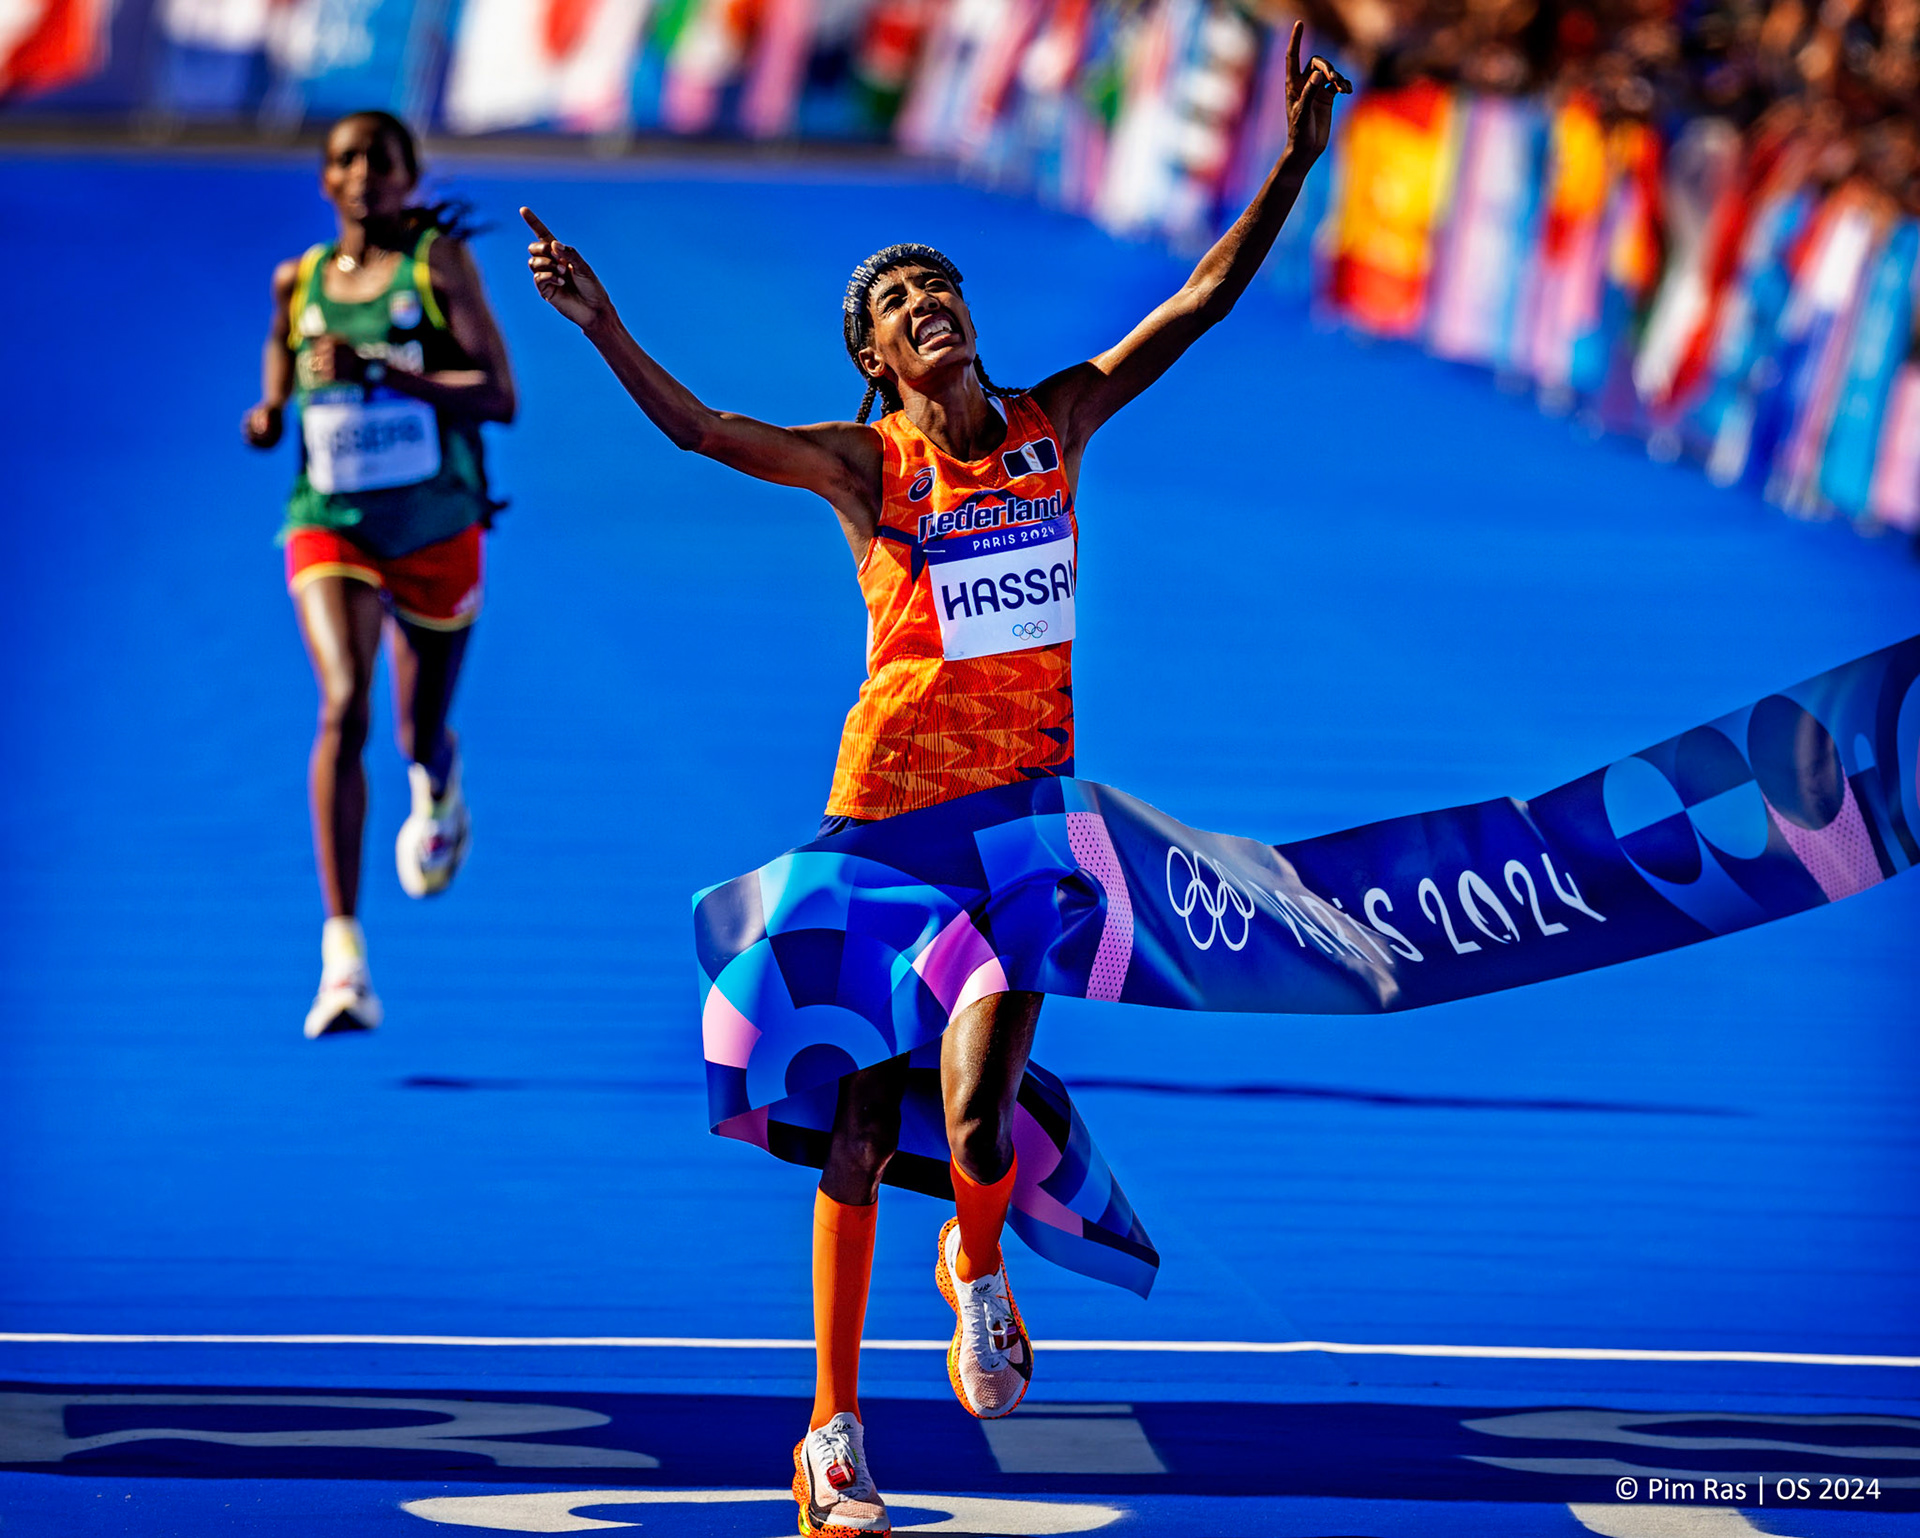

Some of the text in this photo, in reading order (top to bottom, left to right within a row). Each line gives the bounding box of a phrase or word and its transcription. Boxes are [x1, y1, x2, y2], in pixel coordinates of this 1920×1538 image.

[918, 489, 1063, 543] nederland
[1020, 526, 1055, 542] 2024
[1417, 853, 1607, 955] 2024
